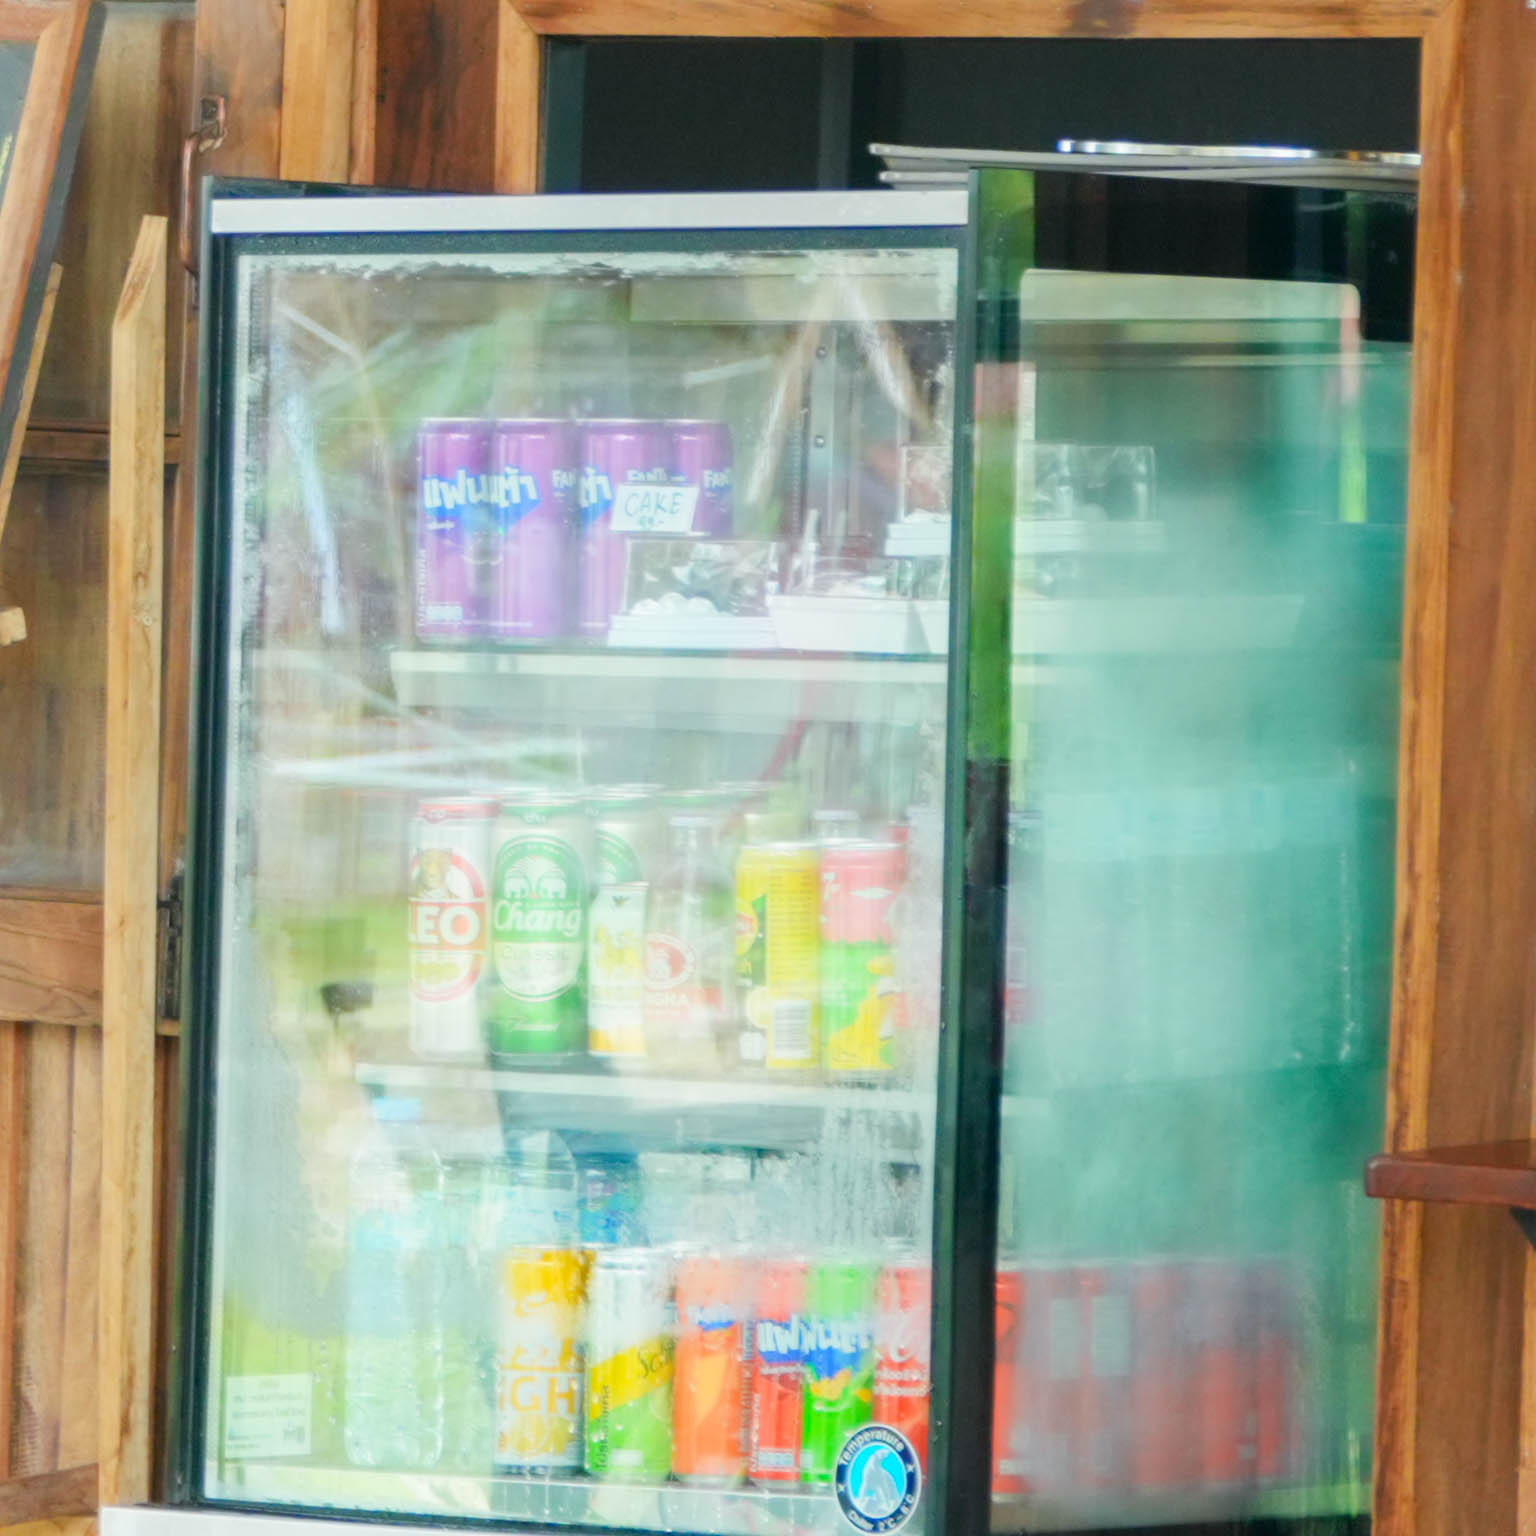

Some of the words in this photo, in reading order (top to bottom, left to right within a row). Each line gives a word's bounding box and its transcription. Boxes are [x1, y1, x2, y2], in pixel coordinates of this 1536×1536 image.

[625, 491, 683, 517] CAKE
[494, 899, 583, 937] Chang
[837, 1429, 906, 1466] Temperature
